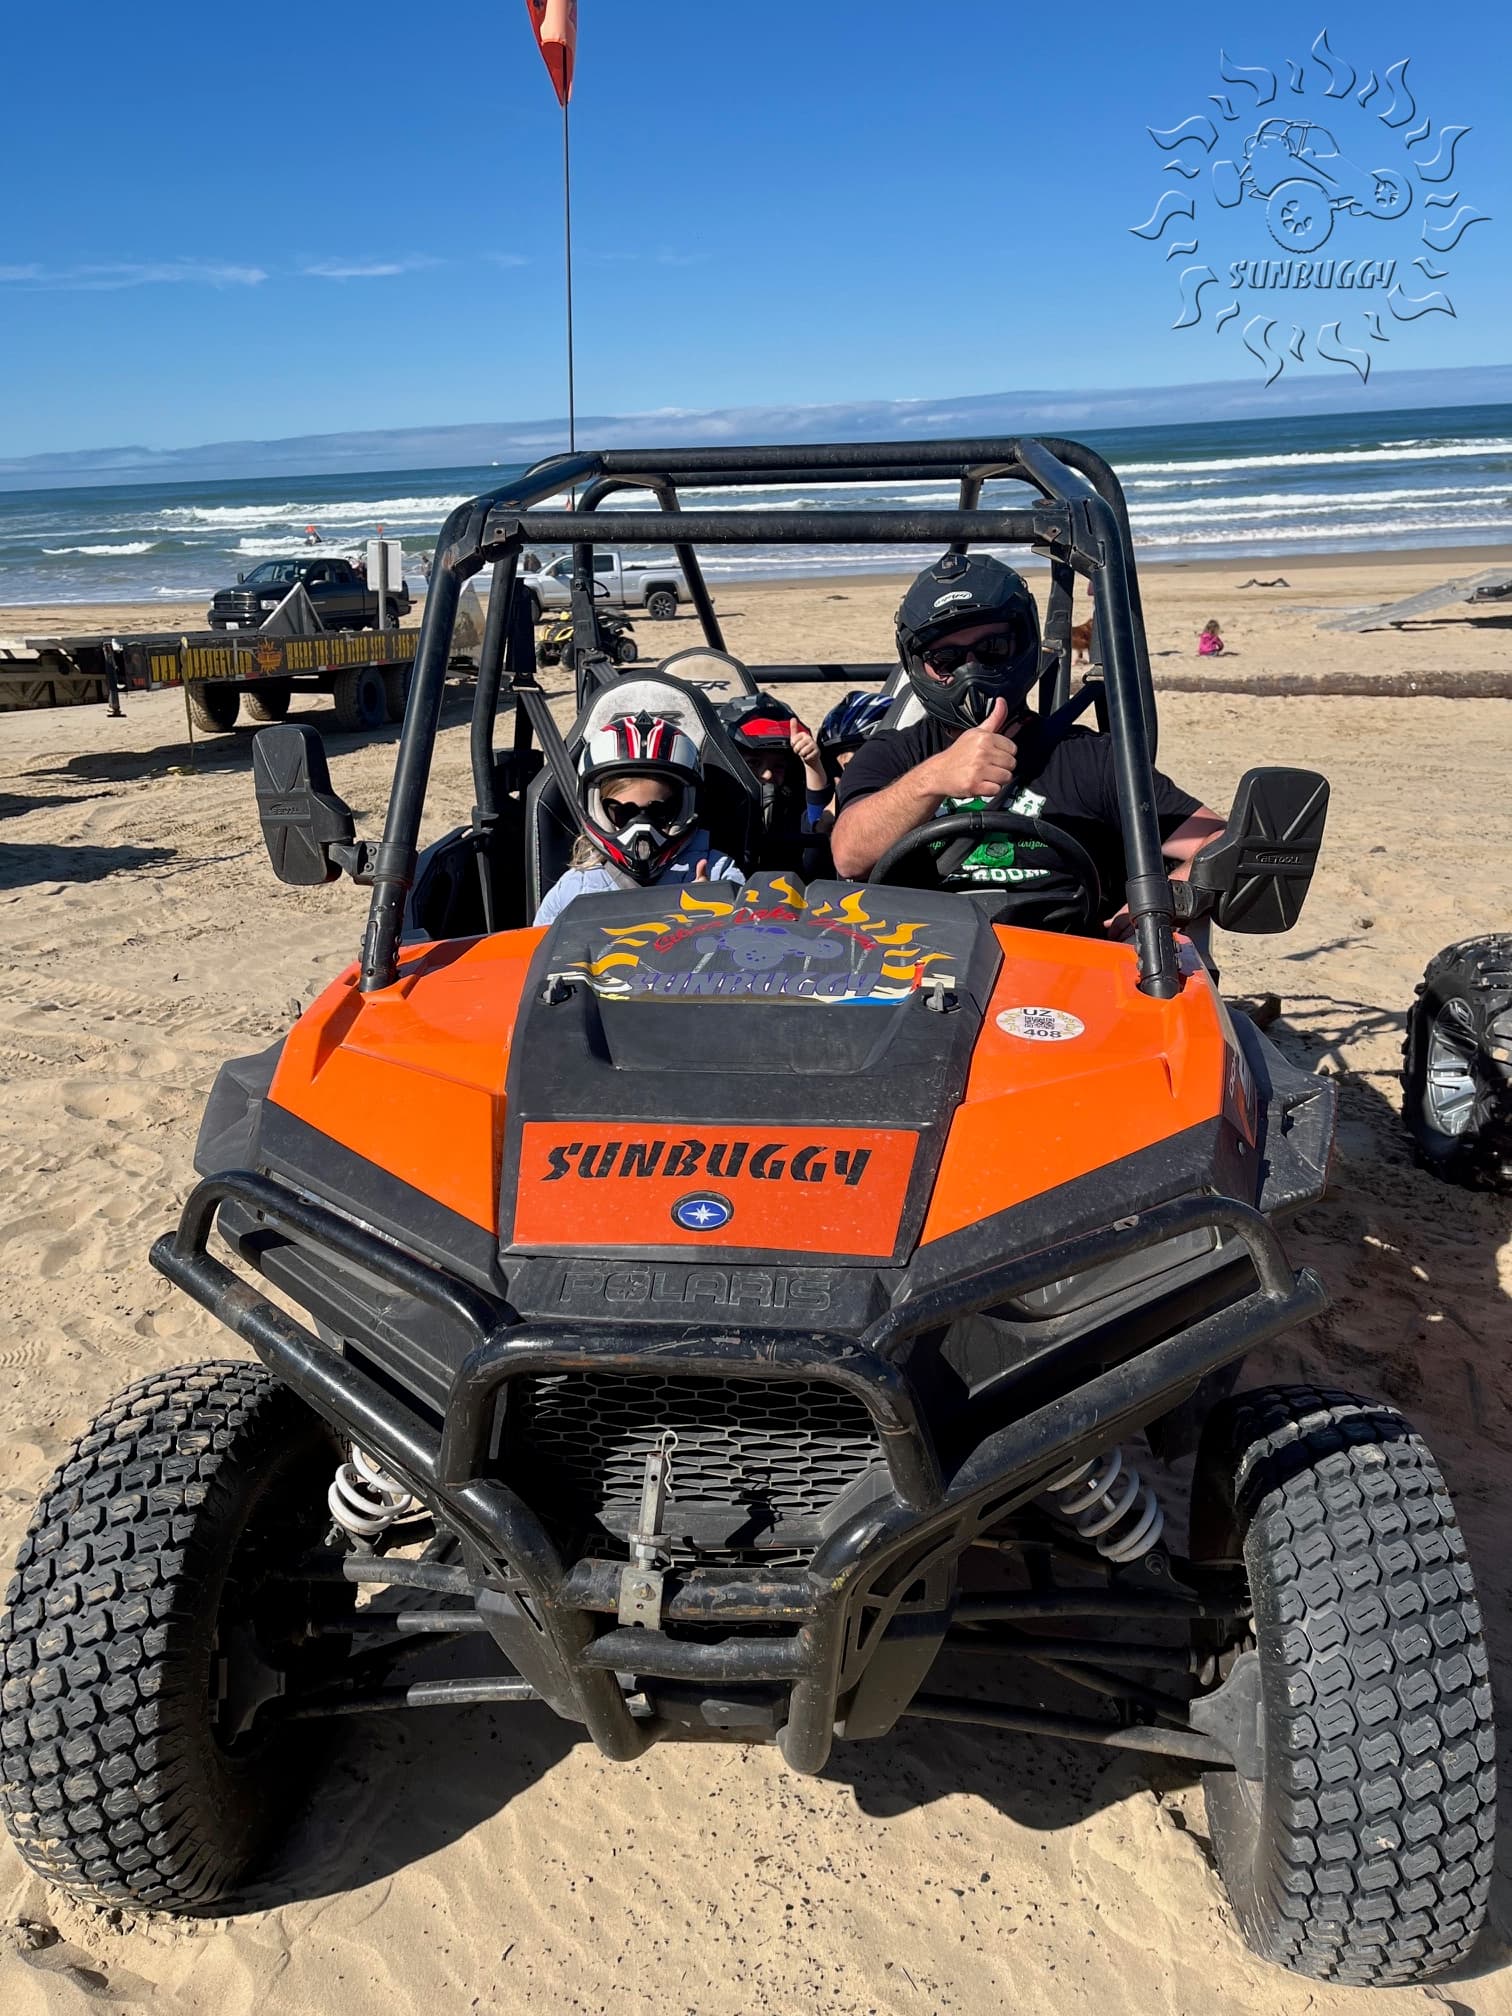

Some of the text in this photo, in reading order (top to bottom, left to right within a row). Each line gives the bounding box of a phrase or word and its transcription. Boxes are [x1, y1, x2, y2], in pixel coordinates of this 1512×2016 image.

[628, 972, 881, 997] SUNBUGGY
[1023, 1008, 1053, 1017] UZ
[1023, 1028, 1062, 1038] 408
[540, 1139, 872, 1186] SUNBUGGY
[558, 1270, 834, 1312] POLARIS
